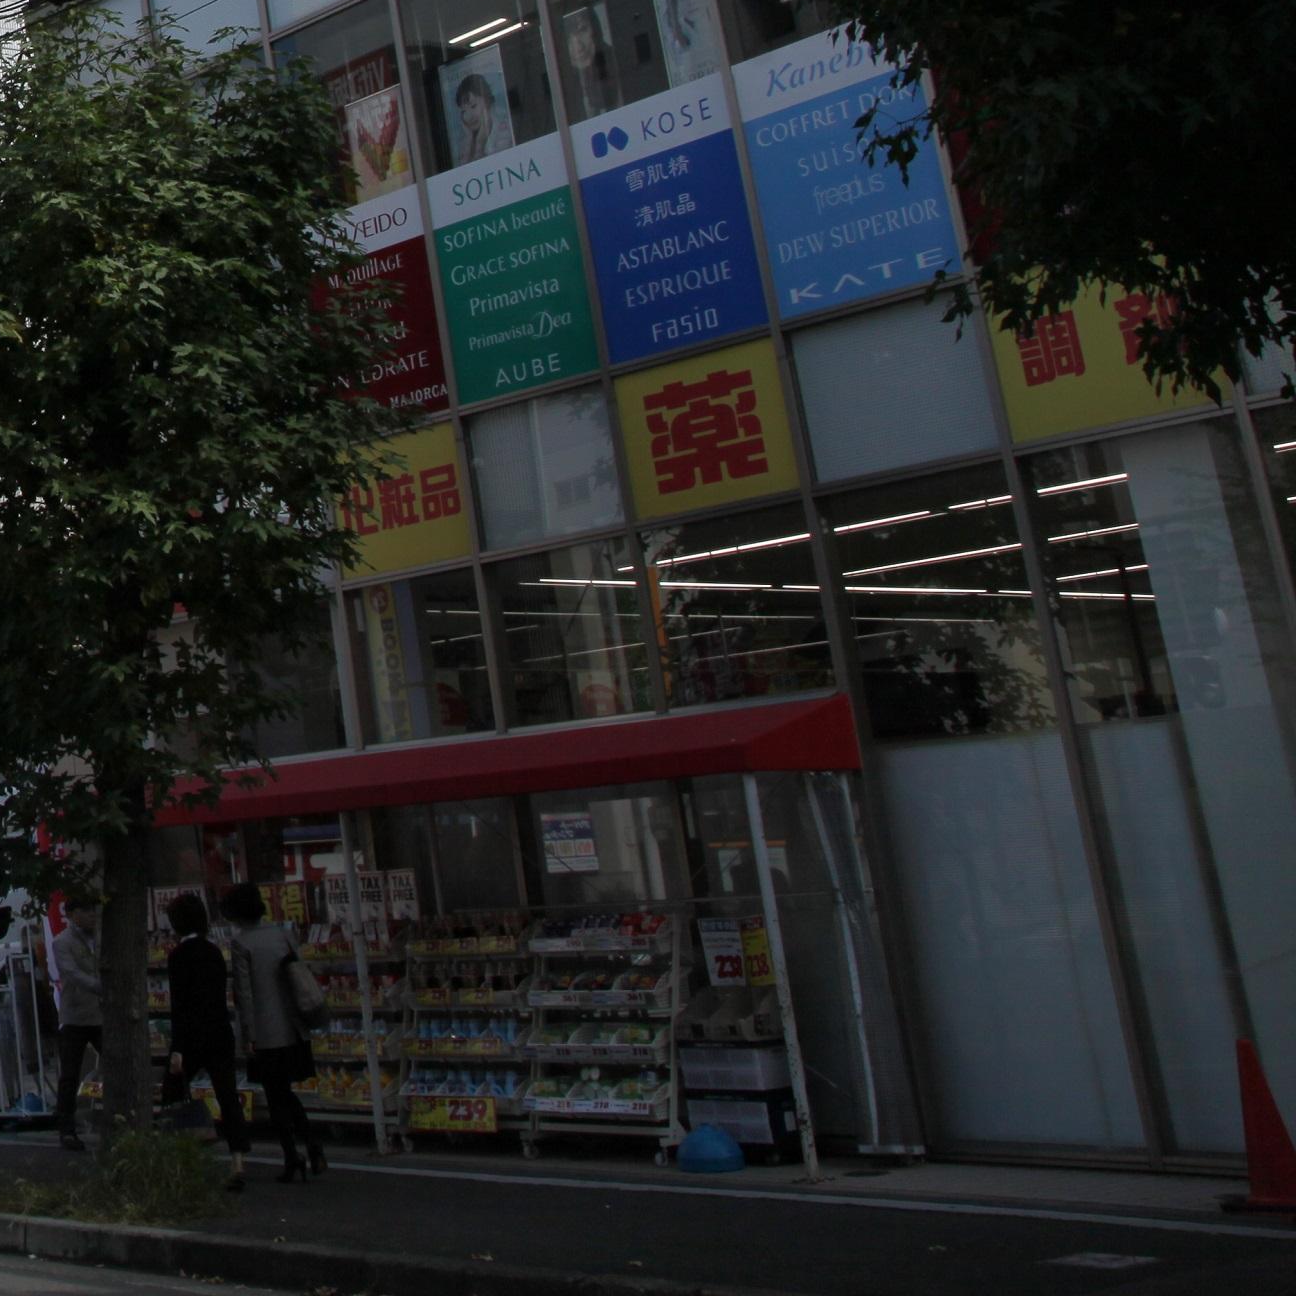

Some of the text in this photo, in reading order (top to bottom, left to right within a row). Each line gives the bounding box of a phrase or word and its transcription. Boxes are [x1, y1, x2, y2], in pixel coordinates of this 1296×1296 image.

[641, 98, 713, 141] KOSE
[756, 100, 851, 148] COFFRET
[452, 158, 541, 206] SOFINA
[625, 156, 690, 192] 雪肌精
[812, 172, 888, 216] freeplus
[443, 197, 567, 254] SOFINA beauté
[634, 193, 697, 228] 清肌晶
[778, 198, 942, 264] DEW SUPERIOR
[451, 237, 571, 287] GRACE SOFINA
[617, 220, 730, 273] ASTABLANC
[469, 276, 560, 317] Primavista
[625, 260, 732, 308] ESPRIQUE
[788, 247, 948, 306] KATE
[469, 322, 535, 351] Primavista
[652, 306, 719, 343] Fasio
[496, 353, 561, 388] AUBE
[643, 369, 769, 496] 薬
[340, 463, 462, 537] 化粧品
[360, 877, 380, 889] TAX
[361, 890, 383, 903] FREE
[714, 954, 743, 979] 238
[448, 1099, 488, 1122] 239
